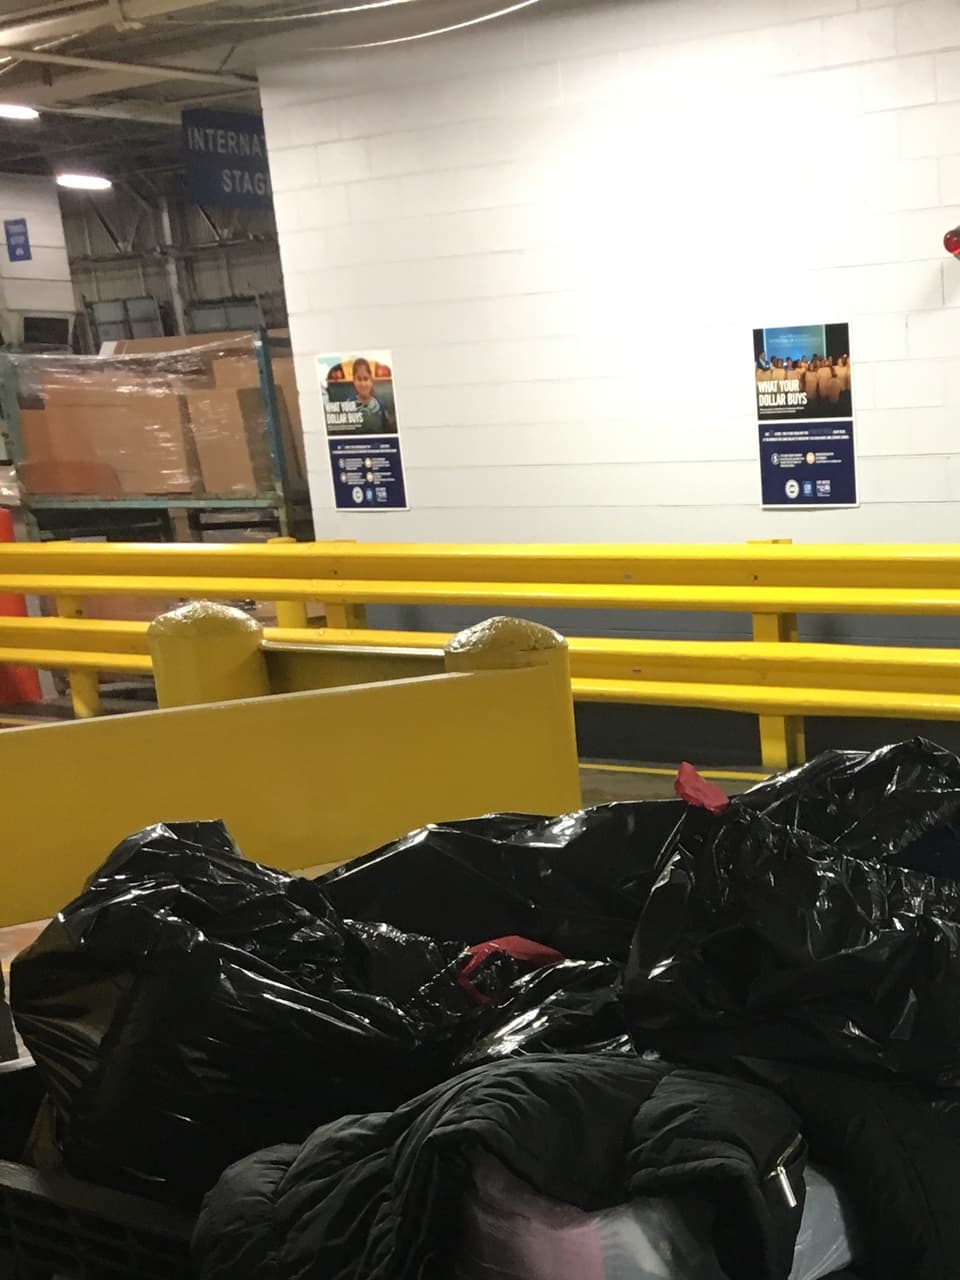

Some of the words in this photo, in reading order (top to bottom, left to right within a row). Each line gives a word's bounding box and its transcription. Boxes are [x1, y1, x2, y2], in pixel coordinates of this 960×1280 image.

[187, 127, 266, 157] INTERNA
[758, 380, 778, 393] WHAT
[779, 379, 800, 392] YOUR
[759, 393, 786, 407] DOLLAR
[787, 392, 808, 405] BUYS
